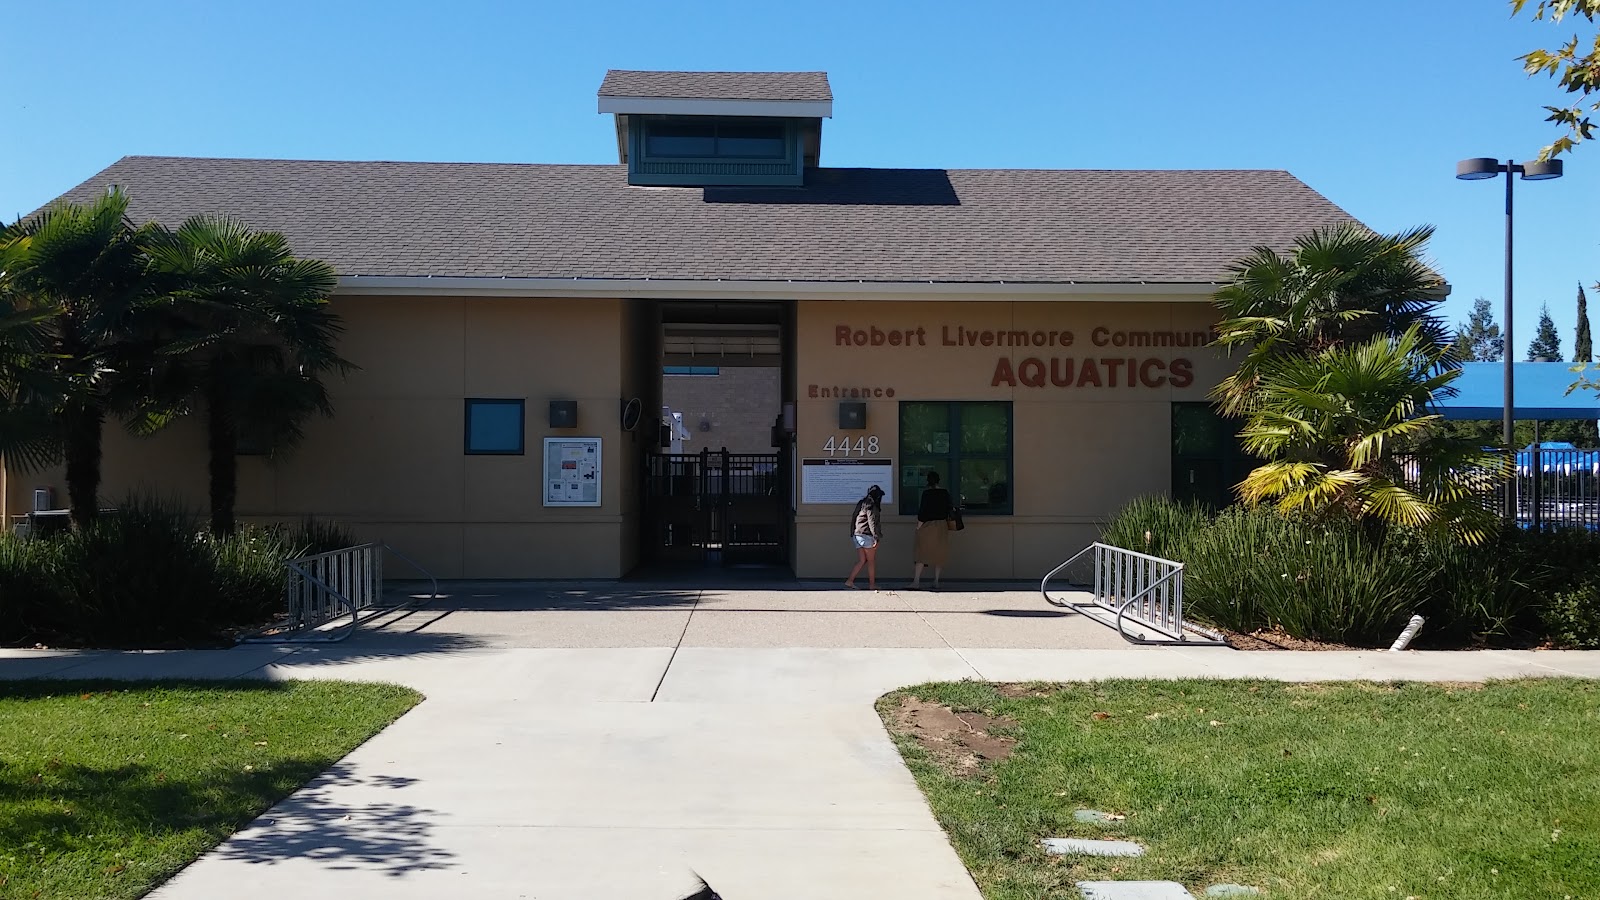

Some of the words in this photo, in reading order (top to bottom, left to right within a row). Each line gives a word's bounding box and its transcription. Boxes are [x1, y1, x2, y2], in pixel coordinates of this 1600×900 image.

[835, 325, 926, 347] Robert
[942, 326, 1074, 347] Livermore
[991, 357, 1194, 389] AQUATICS
[808, 384, 896, 398] Entrance
[822, 435, 880, 457] 4448
